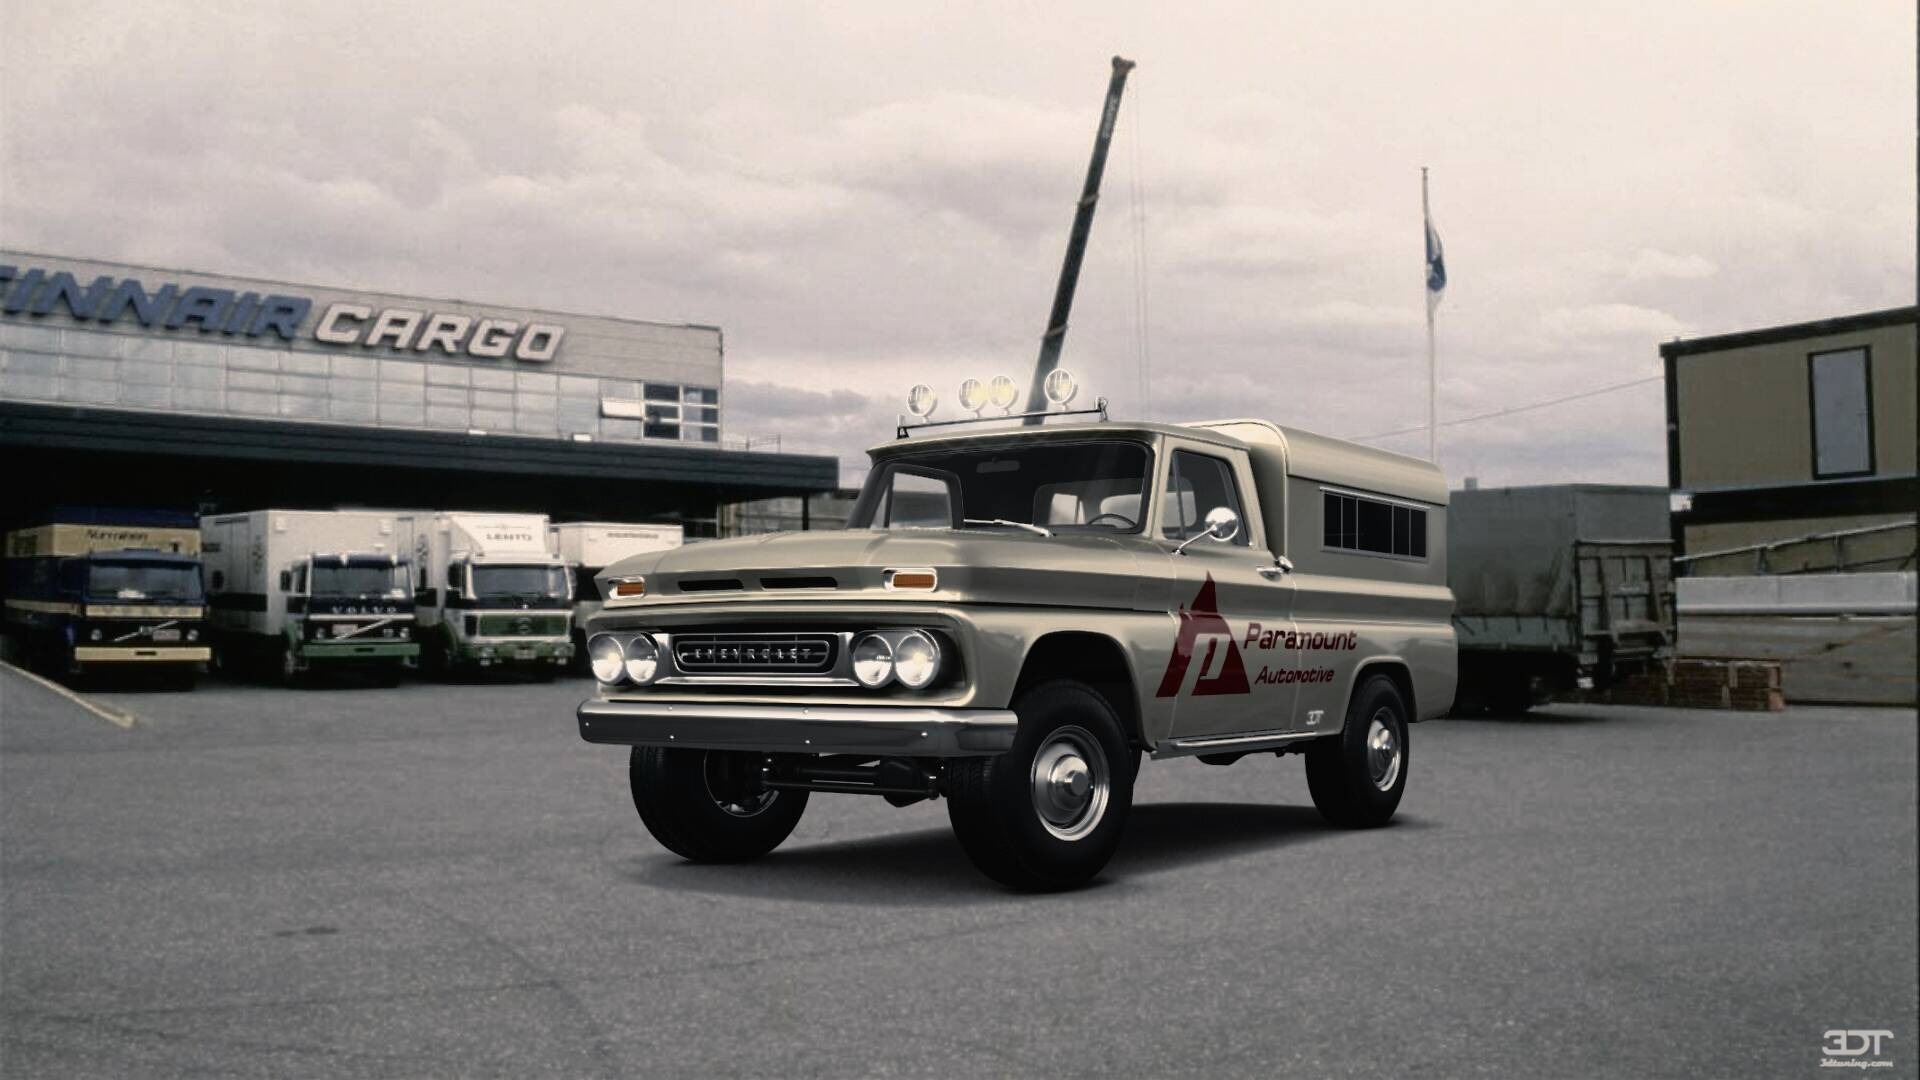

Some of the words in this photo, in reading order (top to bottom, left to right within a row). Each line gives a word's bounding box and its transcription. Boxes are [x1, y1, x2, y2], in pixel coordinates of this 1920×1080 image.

[315, 302, 566, 361] CARGO
[332, 606, 397, 614] VOLVO
[1243, 622, 1357, 650] Paramount
[695, 648, 811, 660] CHEVROLET
[1254, 665, 1335, 685] Automotive
